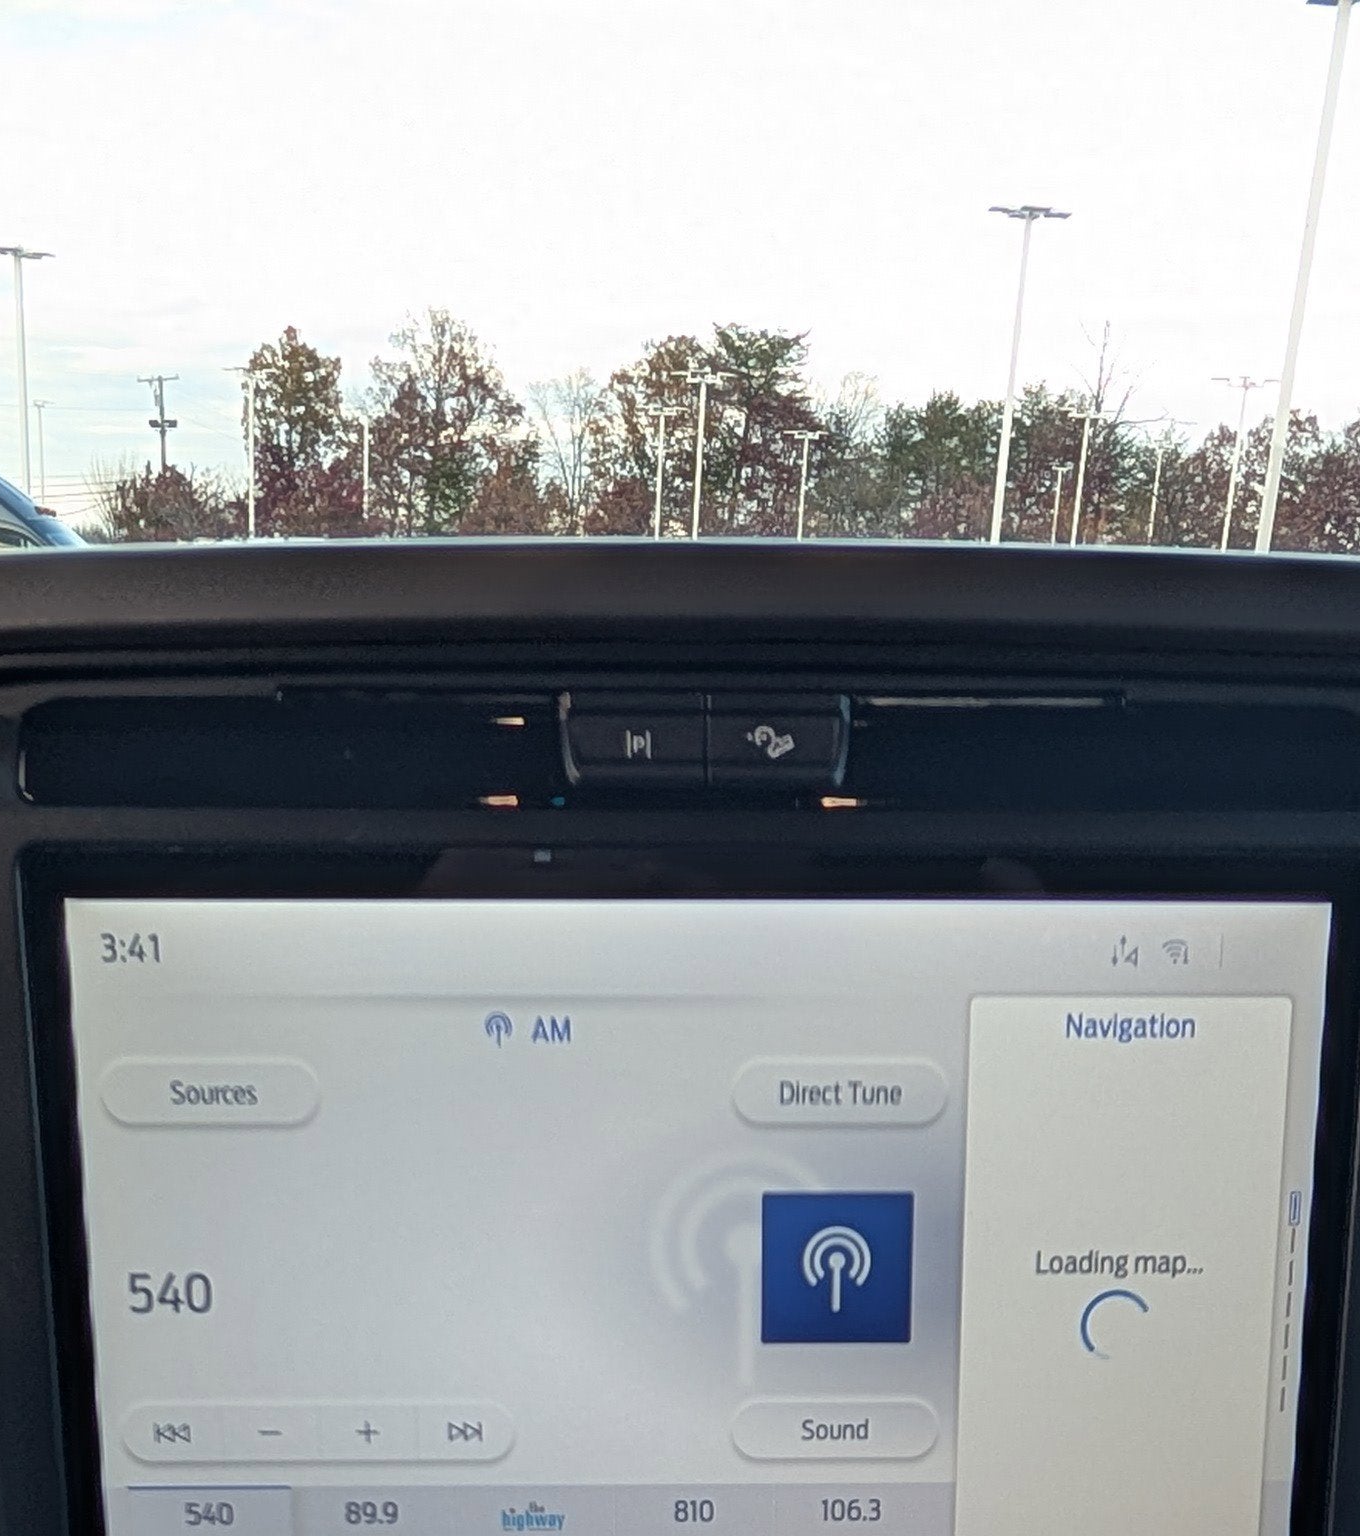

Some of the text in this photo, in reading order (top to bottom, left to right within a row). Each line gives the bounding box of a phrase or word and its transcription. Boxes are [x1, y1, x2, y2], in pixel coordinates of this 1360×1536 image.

[100, 933, 160, 963] 3:41
[531, 1016, 571, 1043] AM
[1066, 1013, 1196, 1044] Navigation
[169, 1080, 258, 1106] Sources
[779, 1080, 903, 1105] Direct Tune
[1035, 1249, 1204, 1279] Loading map...
[128, 1271, 212, 1315] 540
[801, 1418, 869, 1441] Sound
[185, 1502, 234, 1526] 540
[344, 1501, 399, 1525] 89.9
[501, 1507, 566, 1532] highway
[673, 1499, 715, 1523] 810
[821, 1498, 881, 1522] 106.3
